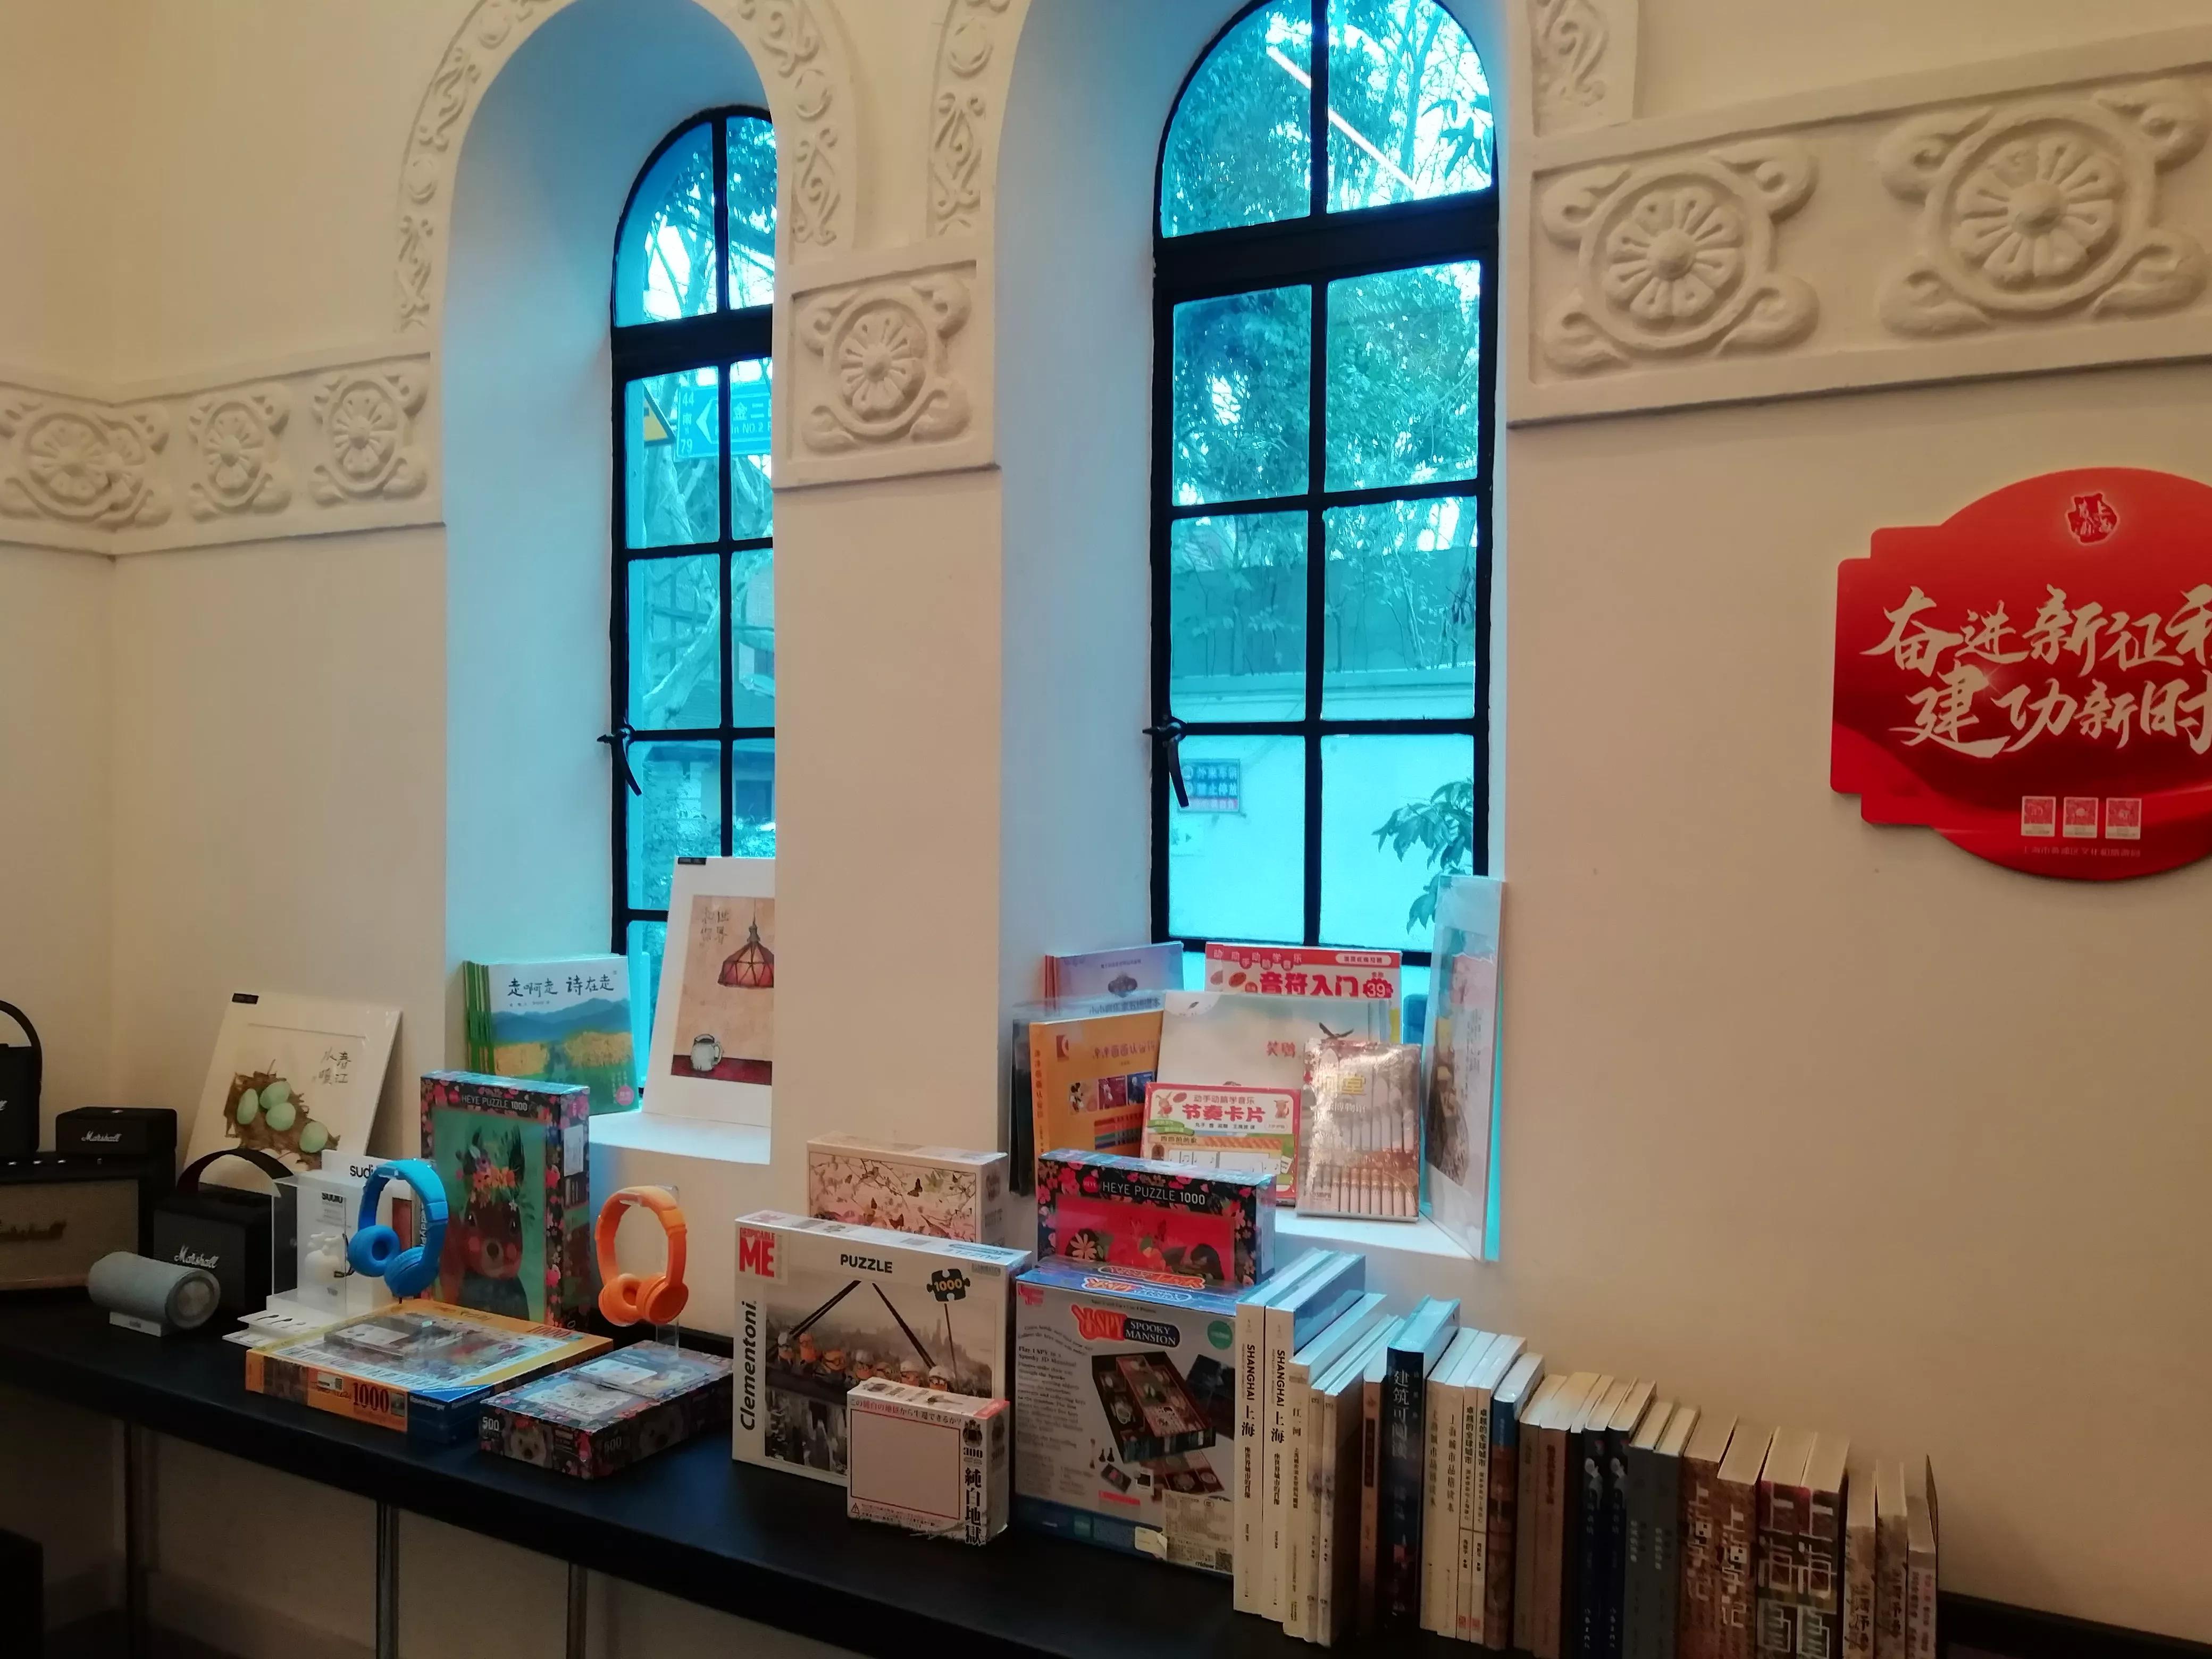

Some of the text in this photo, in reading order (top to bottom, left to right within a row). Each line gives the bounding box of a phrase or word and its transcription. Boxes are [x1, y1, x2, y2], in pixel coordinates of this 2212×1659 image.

[682, 392, 694, 407] 44
[508, 974, 614, 998] 走啊走 诗在走
[1260, 971, 1359, 998] 音符入门
[1367, 983, 1386, 998] 39
[482, 1096, 508, 1109] PUZZLE
[510, 1100, 527, 1111] 1000
[1193, 1094, 1255, 1105] 动手动脑学音乐
[1182, 1104, 1266, 1123] 节奏卡片
[349, 1164, 374, 1179] sudi
[1102, 1182, 1206, 1205] HEYE PUZZLE 1000
[739, 1237, 775, 1278] ME
[840, 1253, 893, 1273] PUZZLE
[934, 1278, 963, 1292] 1000
[1125, 1329, 1177, 1346] MANSION
[1130, 1321, 1171, 1335] SPOOKY
[740, 1301, 757, 1431] Clementoni
[1246, 1344, 1255, 1401] SHANGHAI
[1277, 1350, 1285, 1407] SHANGHAI
[353, 1382, 390, 1413] 1000
[482, 1417, 500, 1432] 500
[1241, 1405, 1255, 1437] 上海
[1271, 1411, 1285, 1443] 上海
[963, 1447, 983, 1459] 300
[965, 1467, 982, 1545] 純白地獄
